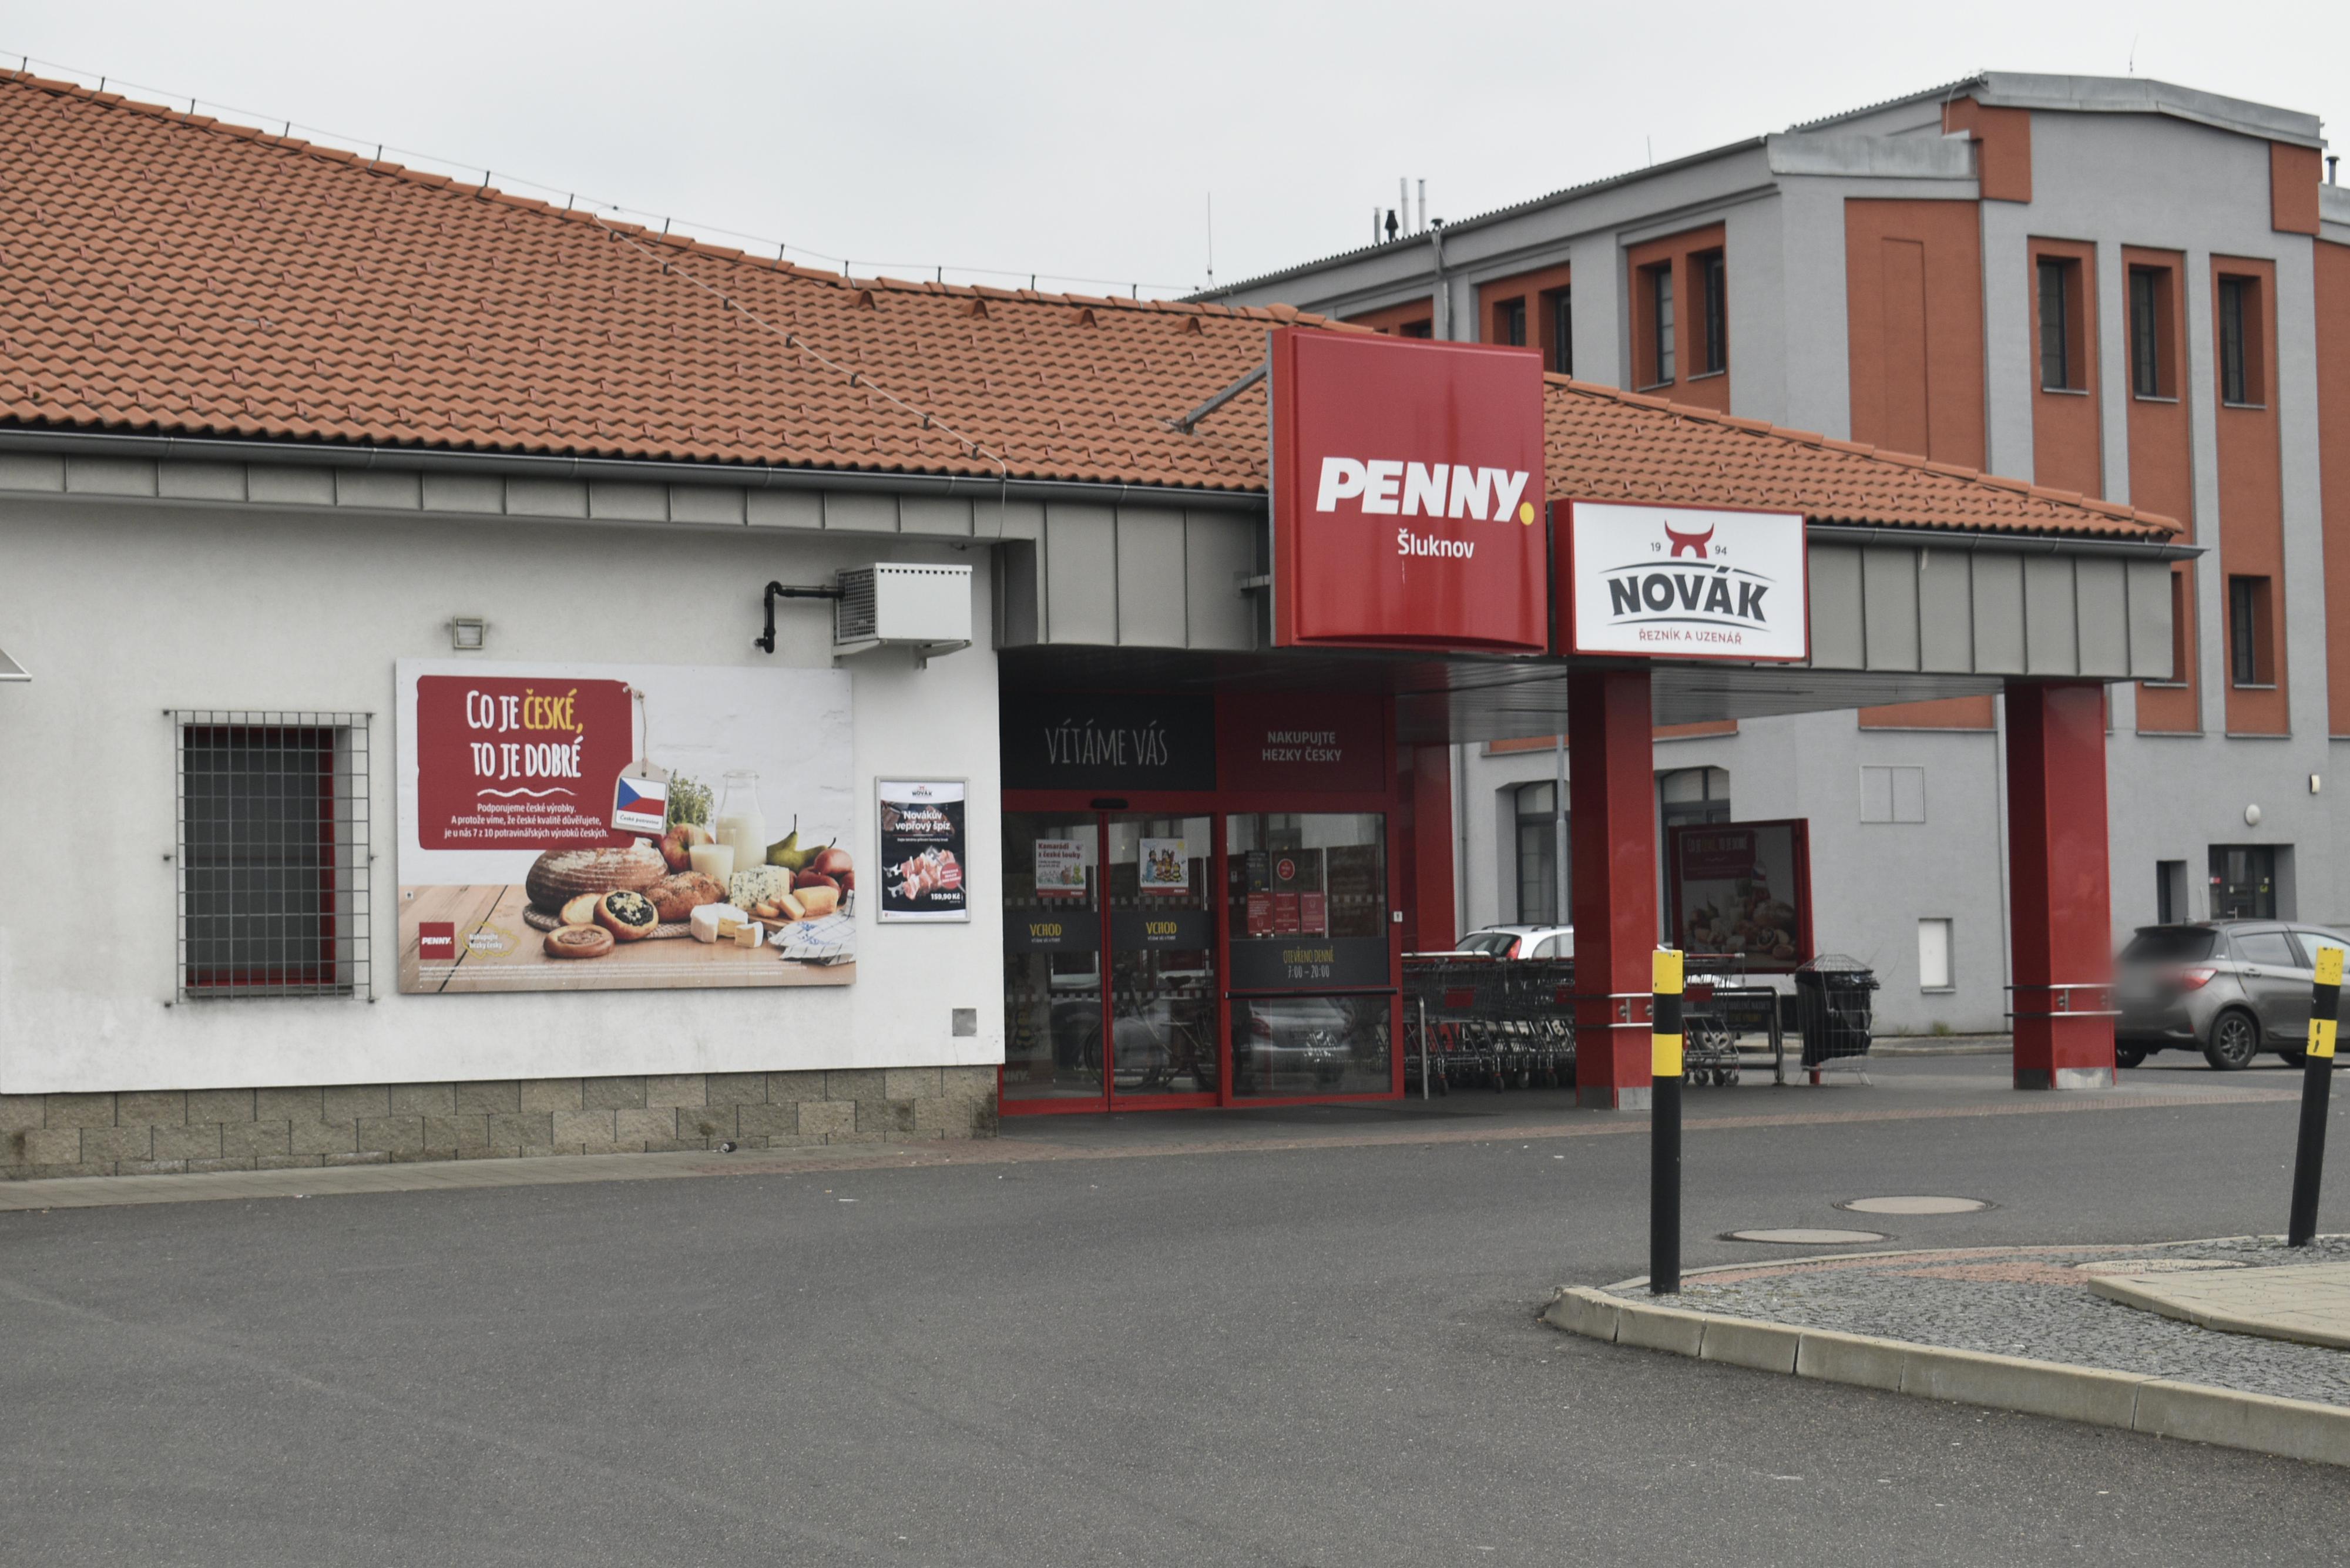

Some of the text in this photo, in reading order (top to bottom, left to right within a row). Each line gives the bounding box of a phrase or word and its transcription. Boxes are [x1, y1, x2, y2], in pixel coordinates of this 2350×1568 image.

[1397, 528, 1475, 559] Šluknov
[1650, 542, 1727, 555] 19 94
[1607, 566, 1769, 623] NOVÁK
[1639, 627, 1680, 642] ŘEZNÍK
[1696, 630, 1742, 644] UZENÁŘ
[466, 688, 583, 734] CO JE ČESKÉ,
[1045, 718, 1168, 766] VÍTÁME VÁS
[1267, 731, 1336, 746] NAKUPUJTE
[470, 735, 584, 781] TO JE DOBRÉ
[1263, 746, 1342, 762] HEZKY ČESKY
[477, 802, 576, 815] Podporujeme české výrobky.
[903, 810, 942, 820] Novákův
[458, 815, 485, 826] protože
[486, 816, 506, 826] víme,
[507, 815, 516, 825] že
[516, 814, 536, 825] české
[537, 814, 561, 825] kvalitě
[561, 815, 602, 827] důvěřujete,
[895, 820, 951, 832] vepřový špíz
[444, 828, 452, 839] je
[459, 828, 472, 838] nás
[472, 829, 478, 838] 7
[485, 828, 494, 838] 10
[494, 828, 550, 840] potravinářských
[550, 828, 579, 839] výrobků
[579, 828, 609, 840] českých.
[1062, 850, 1081, 859] louky
[1029, 923, 1062, 937] VCHOD
[1146, 921, 1177, 935] VCHOD
[1283, 945, 1335, 963] OTEVŘENO DENNĚ
[1288, 965, 1302, 979] 7:00
[1311, 964, 1330, 978] 20:00
